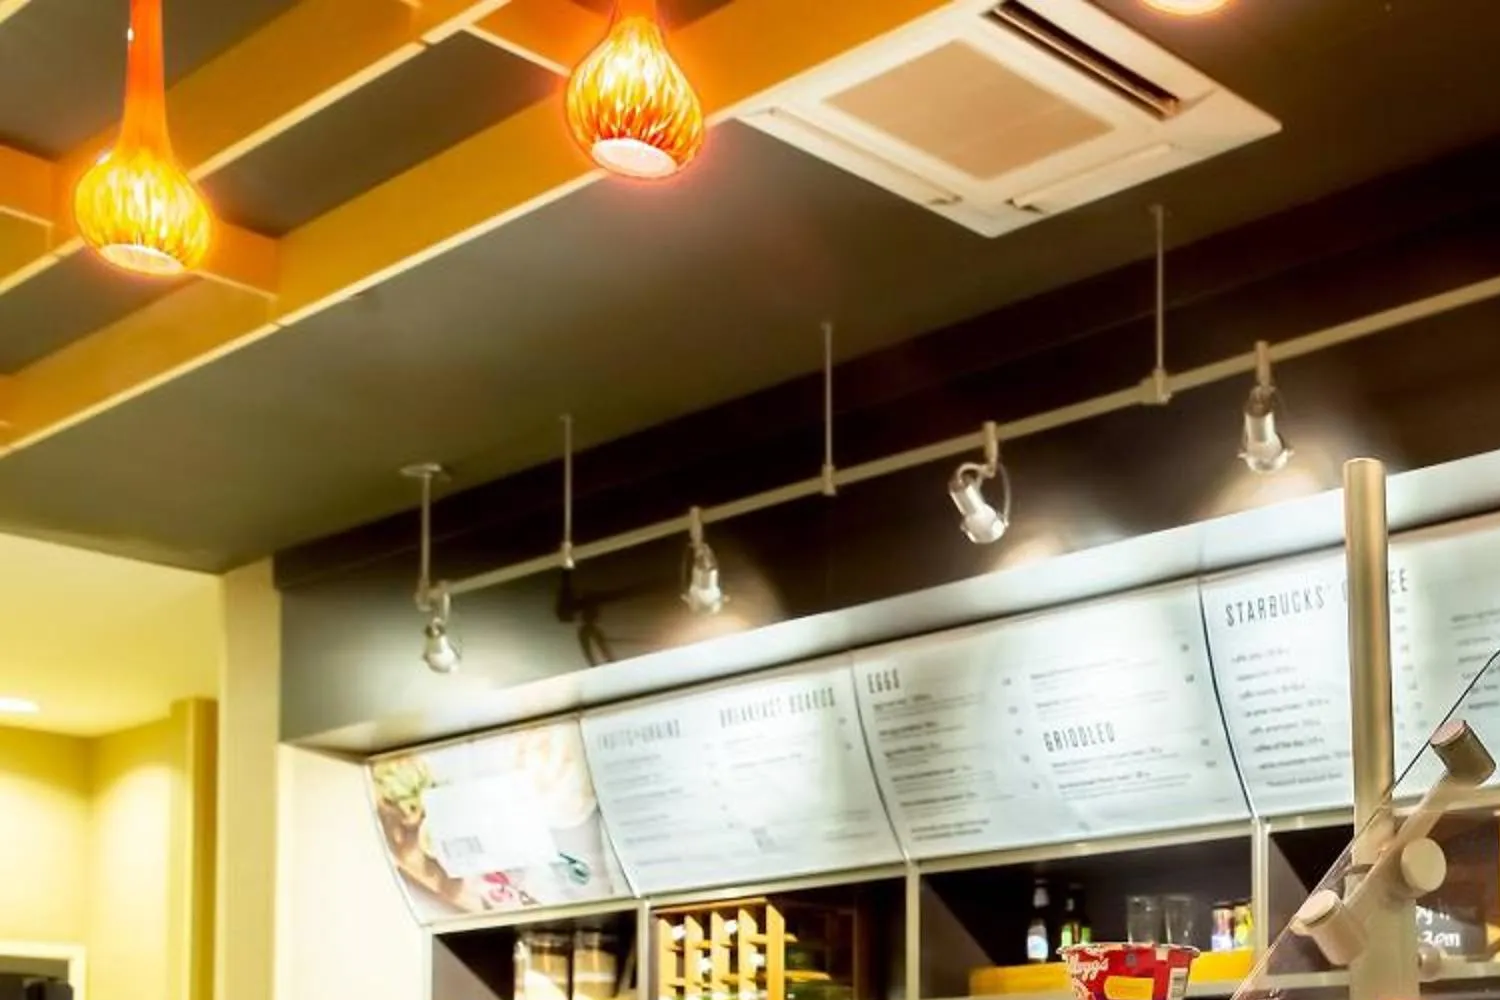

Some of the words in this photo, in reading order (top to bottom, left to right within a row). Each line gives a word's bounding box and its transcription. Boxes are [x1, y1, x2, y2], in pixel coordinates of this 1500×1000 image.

[1224, 585, 1325, 628] STARBUCKS
[867, 667, 900, 694] EGGS
[1043, 721, 1115, 752] GRIDDLED
